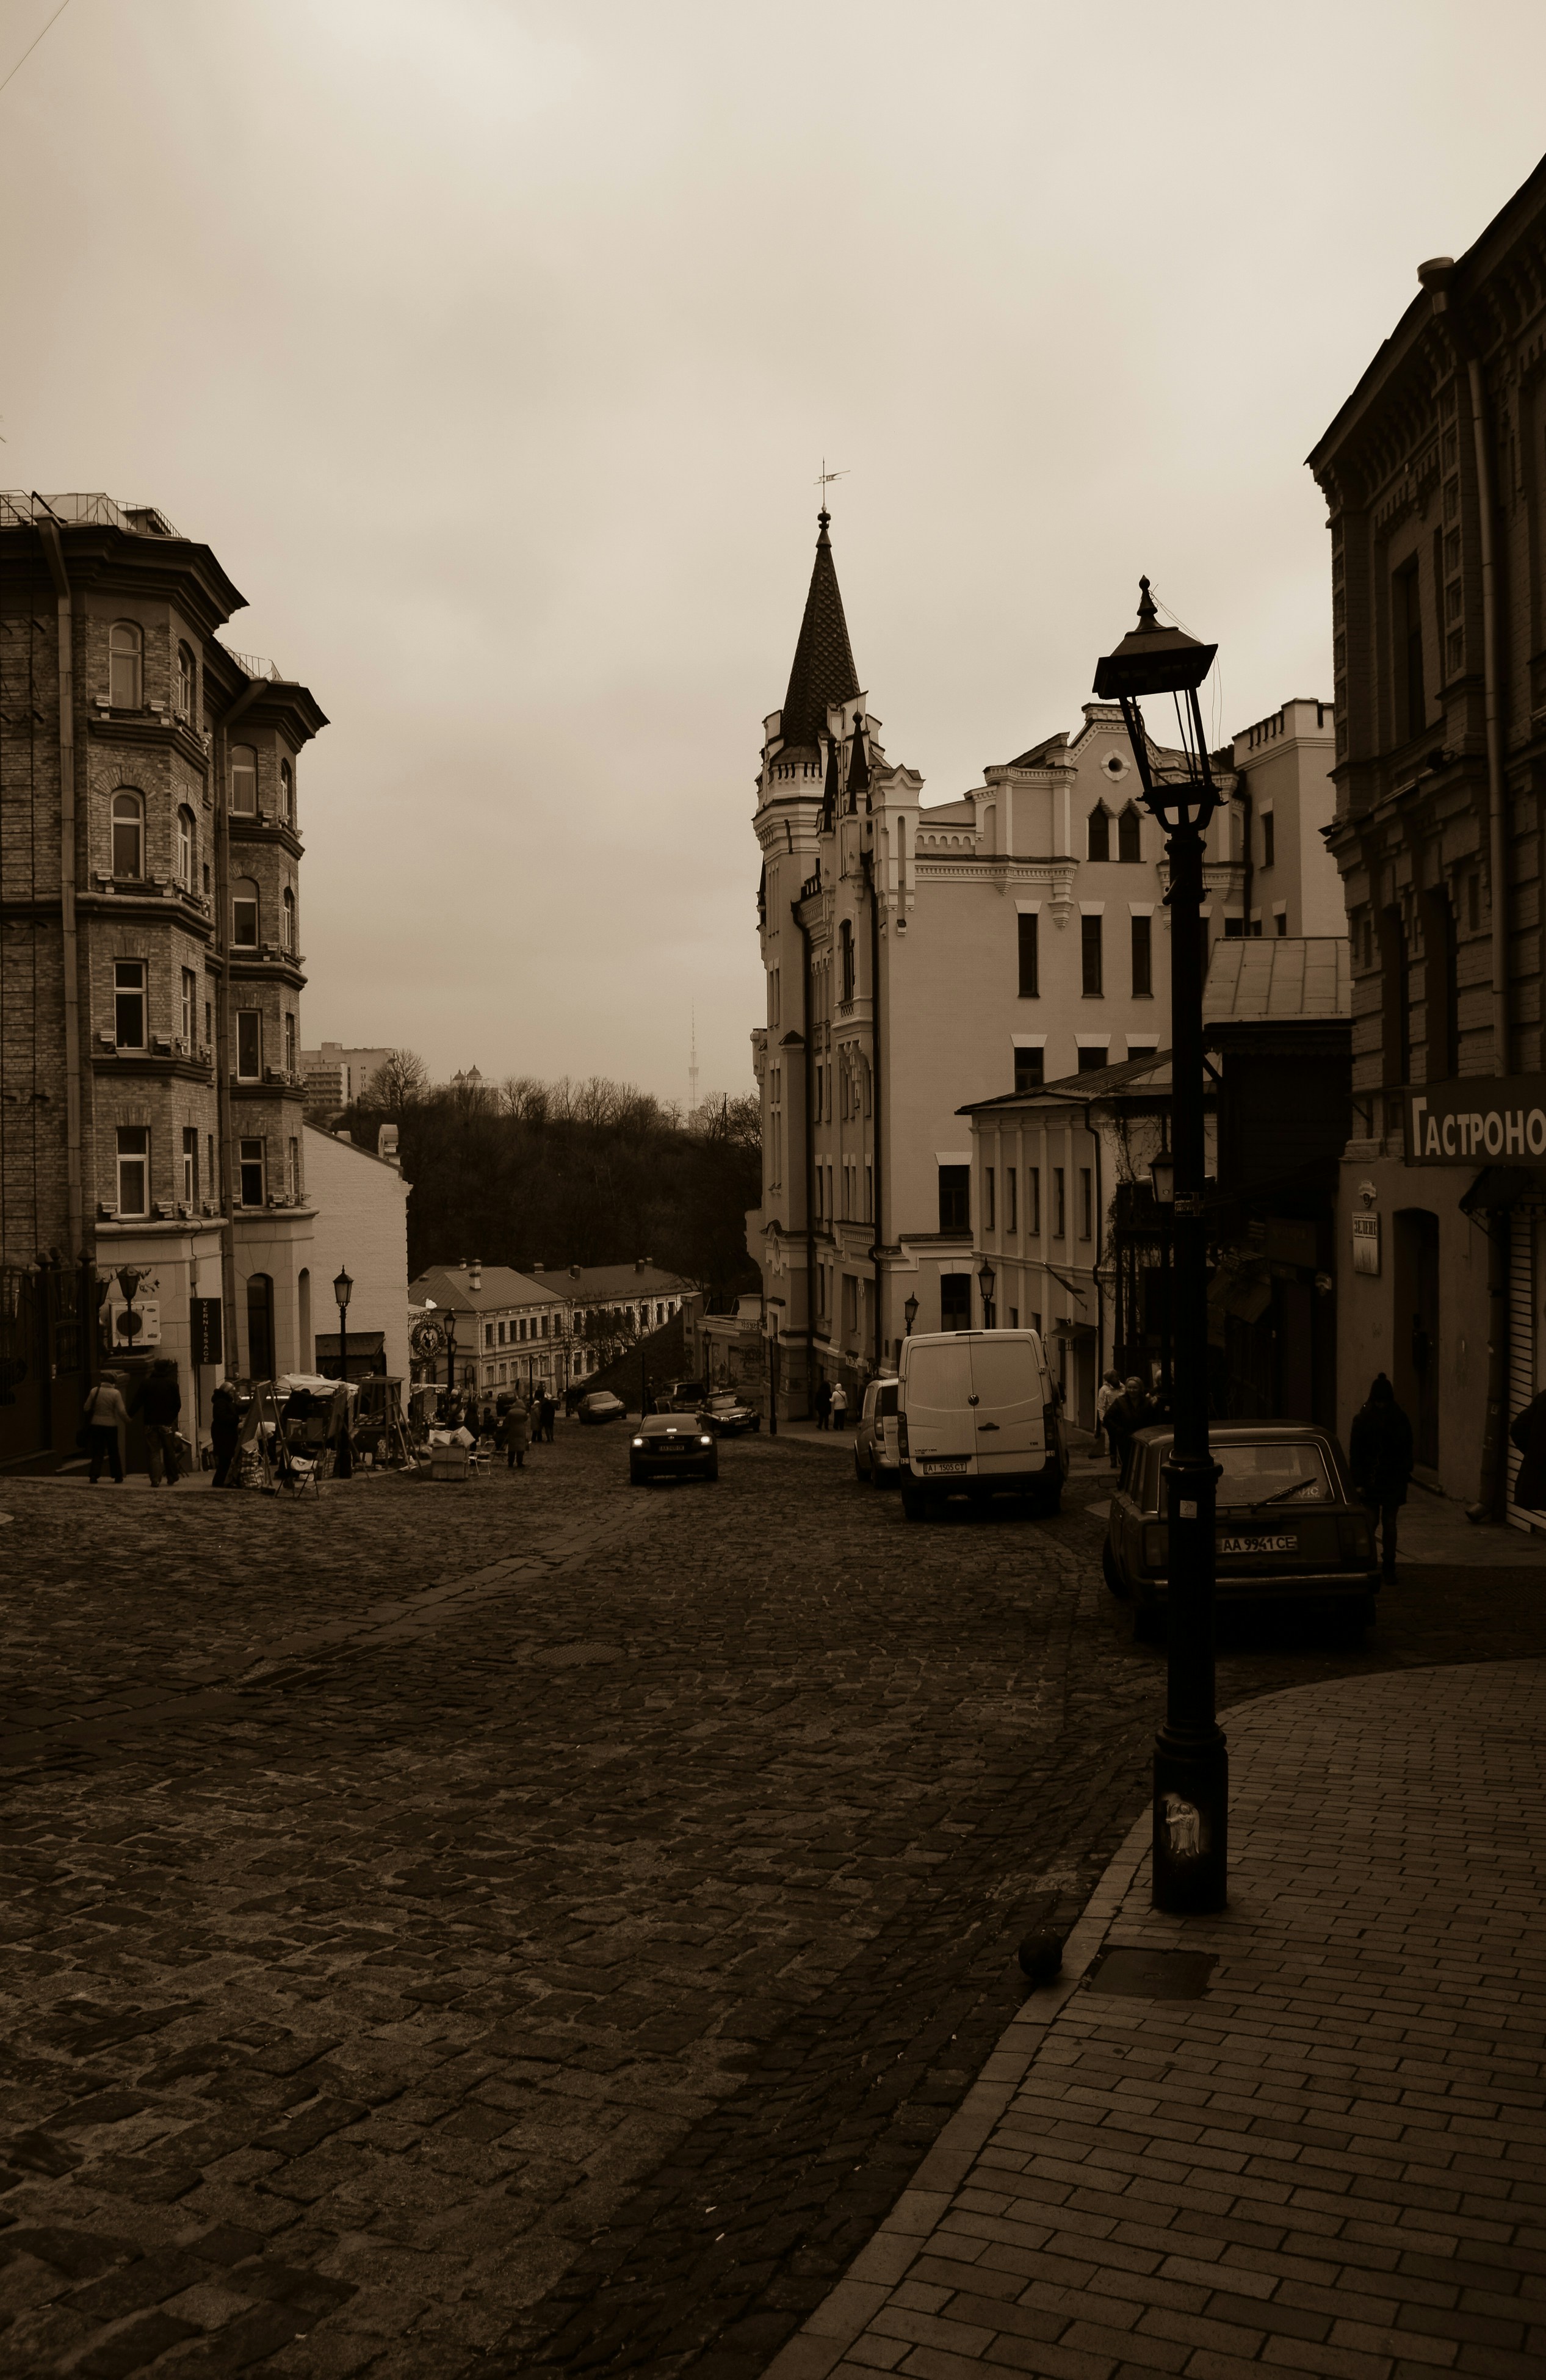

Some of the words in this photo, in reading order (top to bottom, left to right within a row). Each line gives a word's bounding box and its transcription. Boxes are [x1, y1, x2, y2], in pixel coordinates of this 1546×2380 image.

[1412, 1096, 1546, 1156] ГАСТРОНО
[1224, 1538, 1241, 1551] AA
[1244, 1537, 1273, 1550] 9941
[1276, 1536, 1296, 1549] CE
